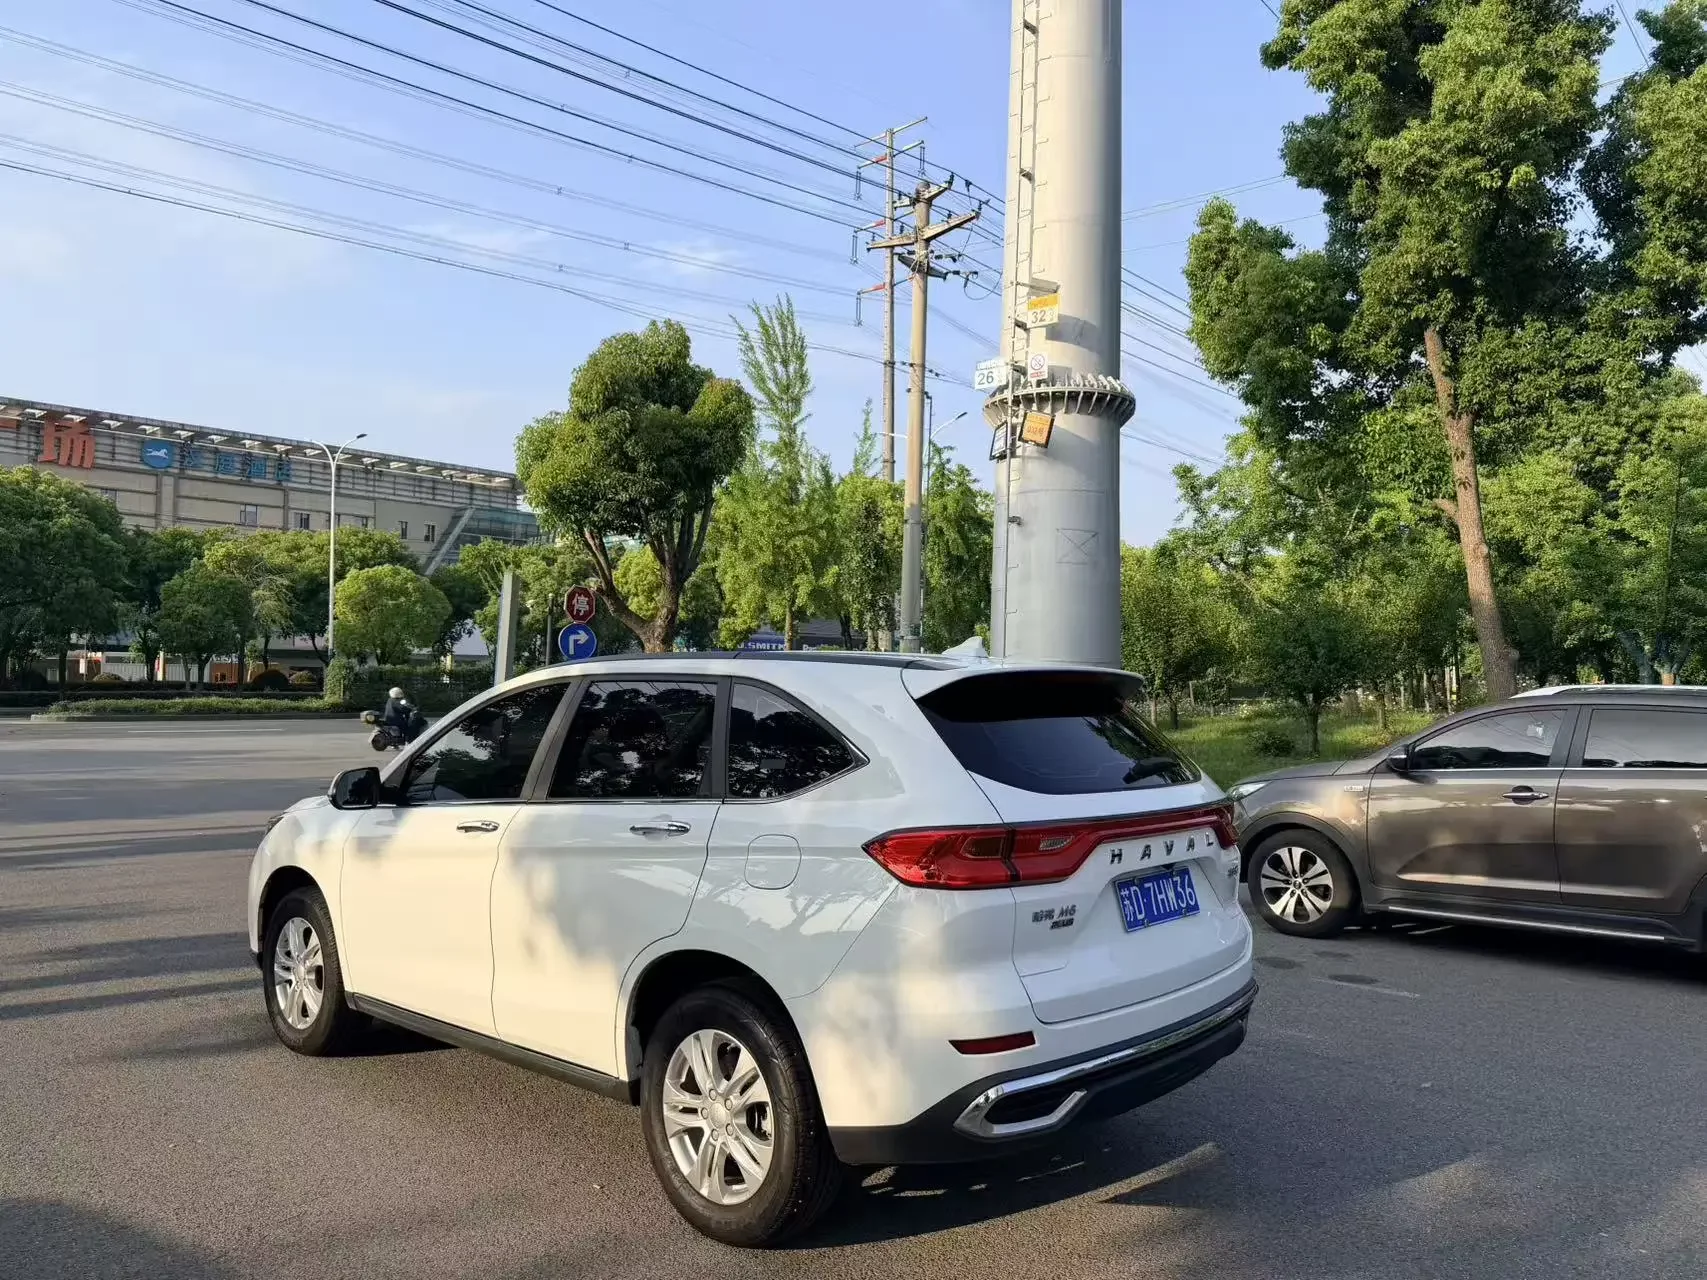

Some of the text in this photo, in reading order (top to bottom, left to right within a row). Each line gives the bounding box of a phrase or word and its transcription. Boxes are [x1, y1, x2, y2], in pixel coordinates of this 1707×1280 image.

[571, 592, 590, 616] 停
[1109, 831, 1215, 865] HAVAL
[1120, 874, 1196, 922] 苏D·7HW36
